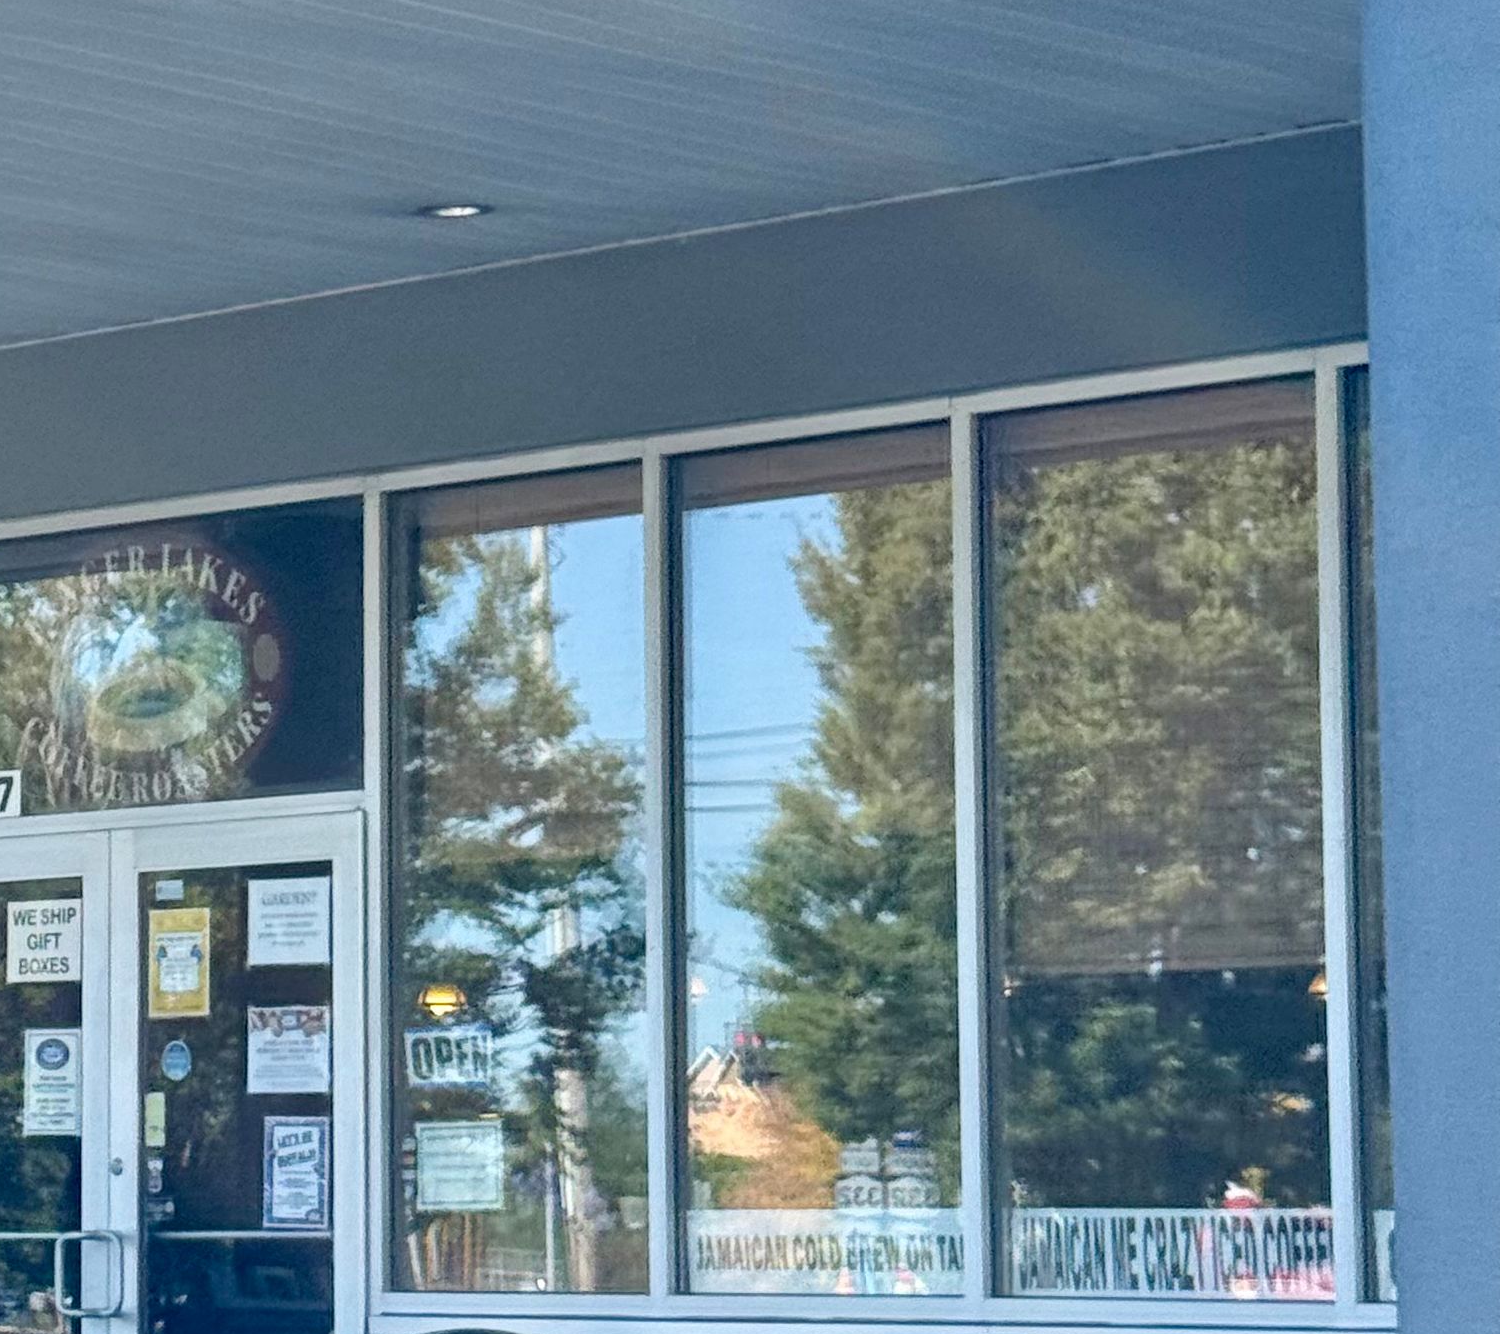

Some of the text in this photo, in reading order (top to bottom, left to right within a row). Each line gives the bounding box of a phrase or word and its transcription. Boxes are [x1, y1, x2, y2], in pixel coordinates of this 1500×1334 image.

[162, 543, 267, 625] LAKES
[13, 906, 77, 927] WE SHIP
[26, 932, 63, 951] GIFT
[18, 956, 70, 976] BOXES
[411, 1034, 489, 1081] OPEN
[696, 1229, 965, 1272] JAMAICAN COLD BREW ON TA
[1111, 1216, 1141, 1292] ME
[1144, 1216, 1204, 1293] CRAZY
[1263, 1215, 1335, 1293] COFFE
